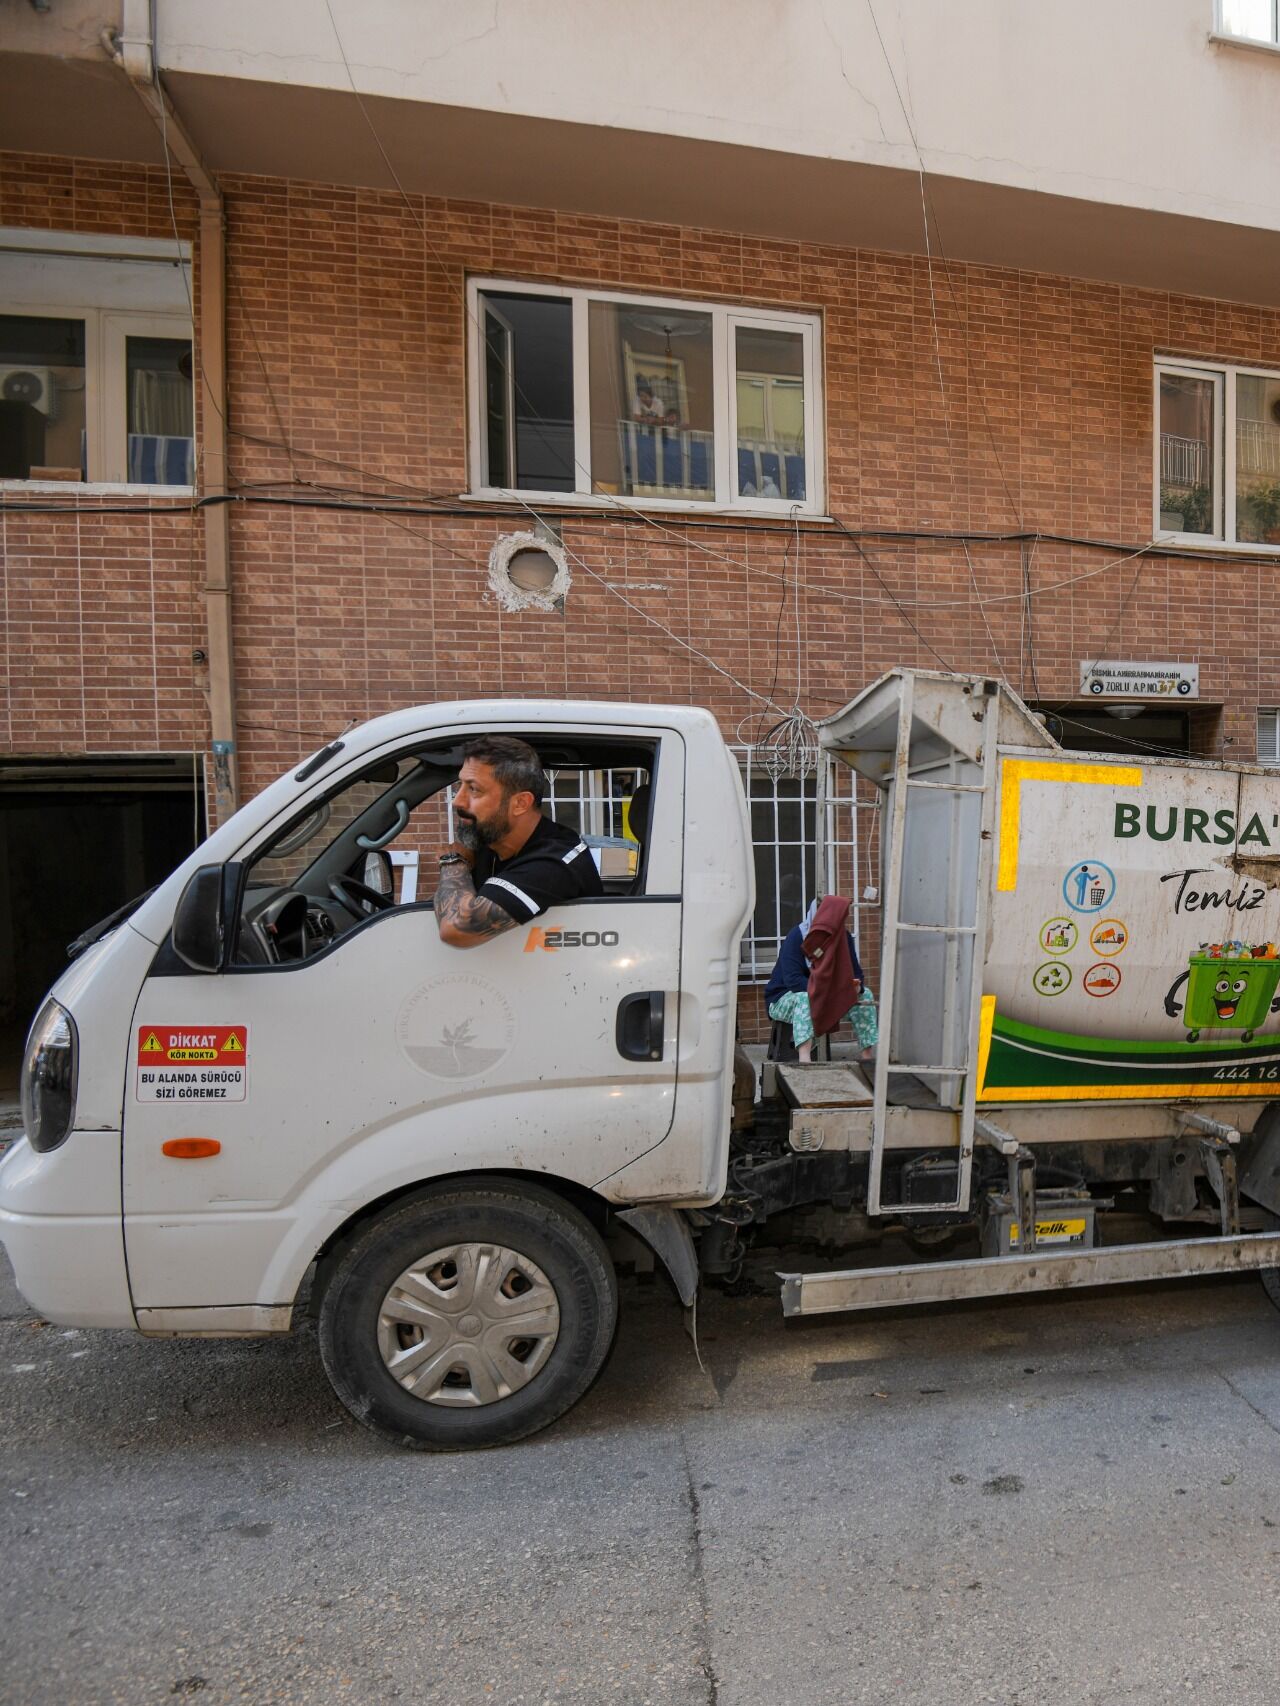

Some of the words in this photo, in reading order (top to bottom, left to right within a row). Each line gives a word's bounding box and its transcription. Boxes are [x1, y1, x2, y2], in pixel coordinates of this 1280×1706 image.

[1160, 868, 1266, 915] Temiz
[169, 1032, 217, 1048] DİKKAT
[170, 1050, 186, 1059] KÖR
[188, 1051, 214, 1059] NOKTA
[141, 1073, 155, 1083] BU
[158, 1073, 197, 1083] ALANDA
[200, 1071, 241, 1083] SÜRÜCÜ
[1213, 1067, 1250, 1080] 444
[1258, 1067, 1278, 1079] 16
[156, 1087, 175, 1098] SİZİ
[178, 1087, 227, 1098] GÖREMEZ
